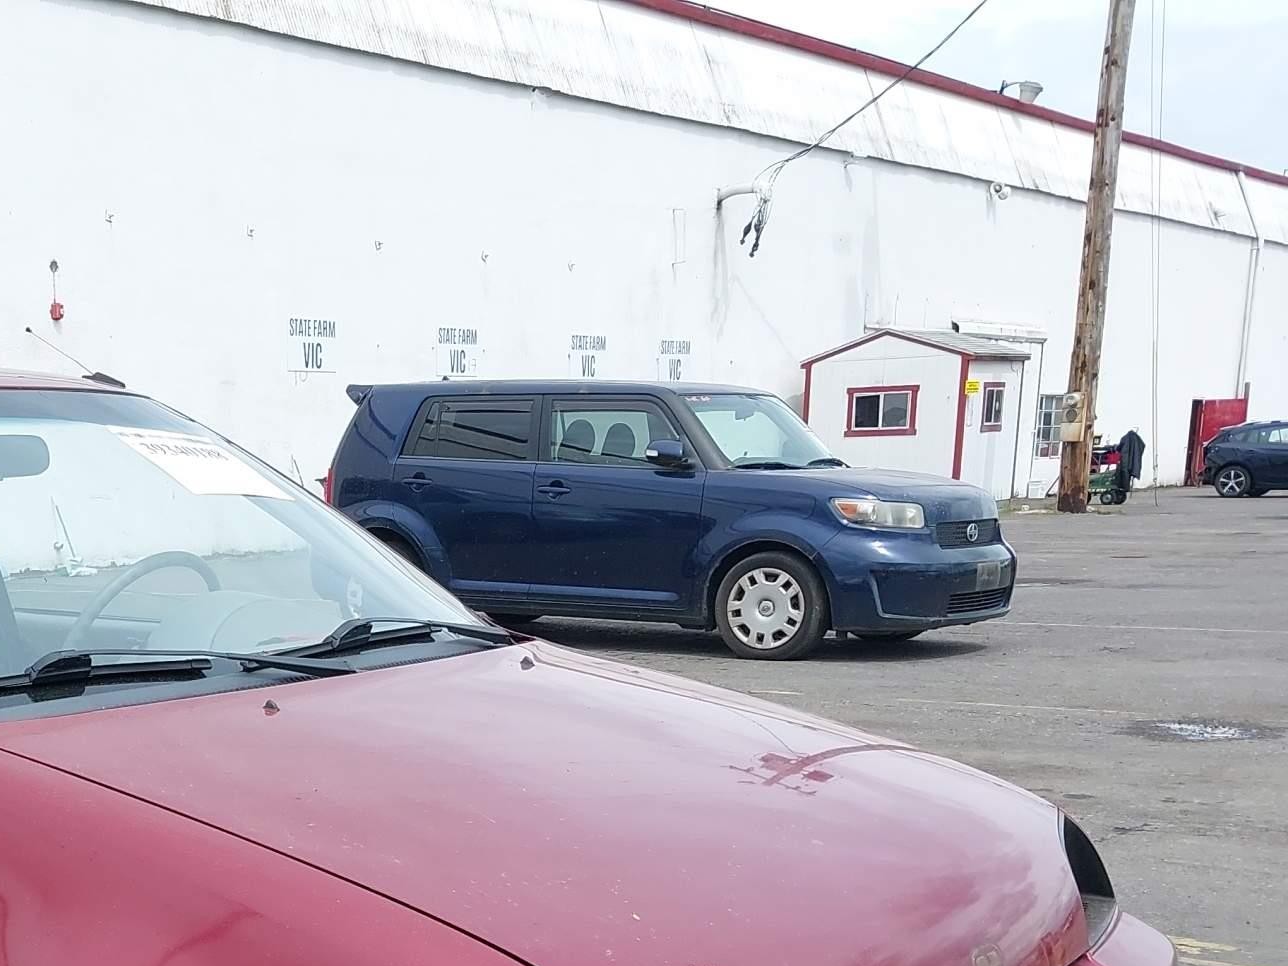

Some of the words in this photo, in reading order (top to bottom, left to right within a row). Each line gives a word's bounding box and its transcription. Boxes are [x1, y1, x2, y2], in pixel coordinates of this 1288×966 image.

[289, 318, 312, 337] STATE
[313, 319, 336, 338] FARM
[438, 327, 457, 345] STATE
[457, 328, 478, 345] FARM
[571, 335, 589, 351] STATE
[589, 335, 606, 352] FARM
[303, 342, 323, 369] VIC
[449, 349, 466, 374] VIC
[581, 355, 596, 378] VIC
[668, 358, 682, 381] VIC
